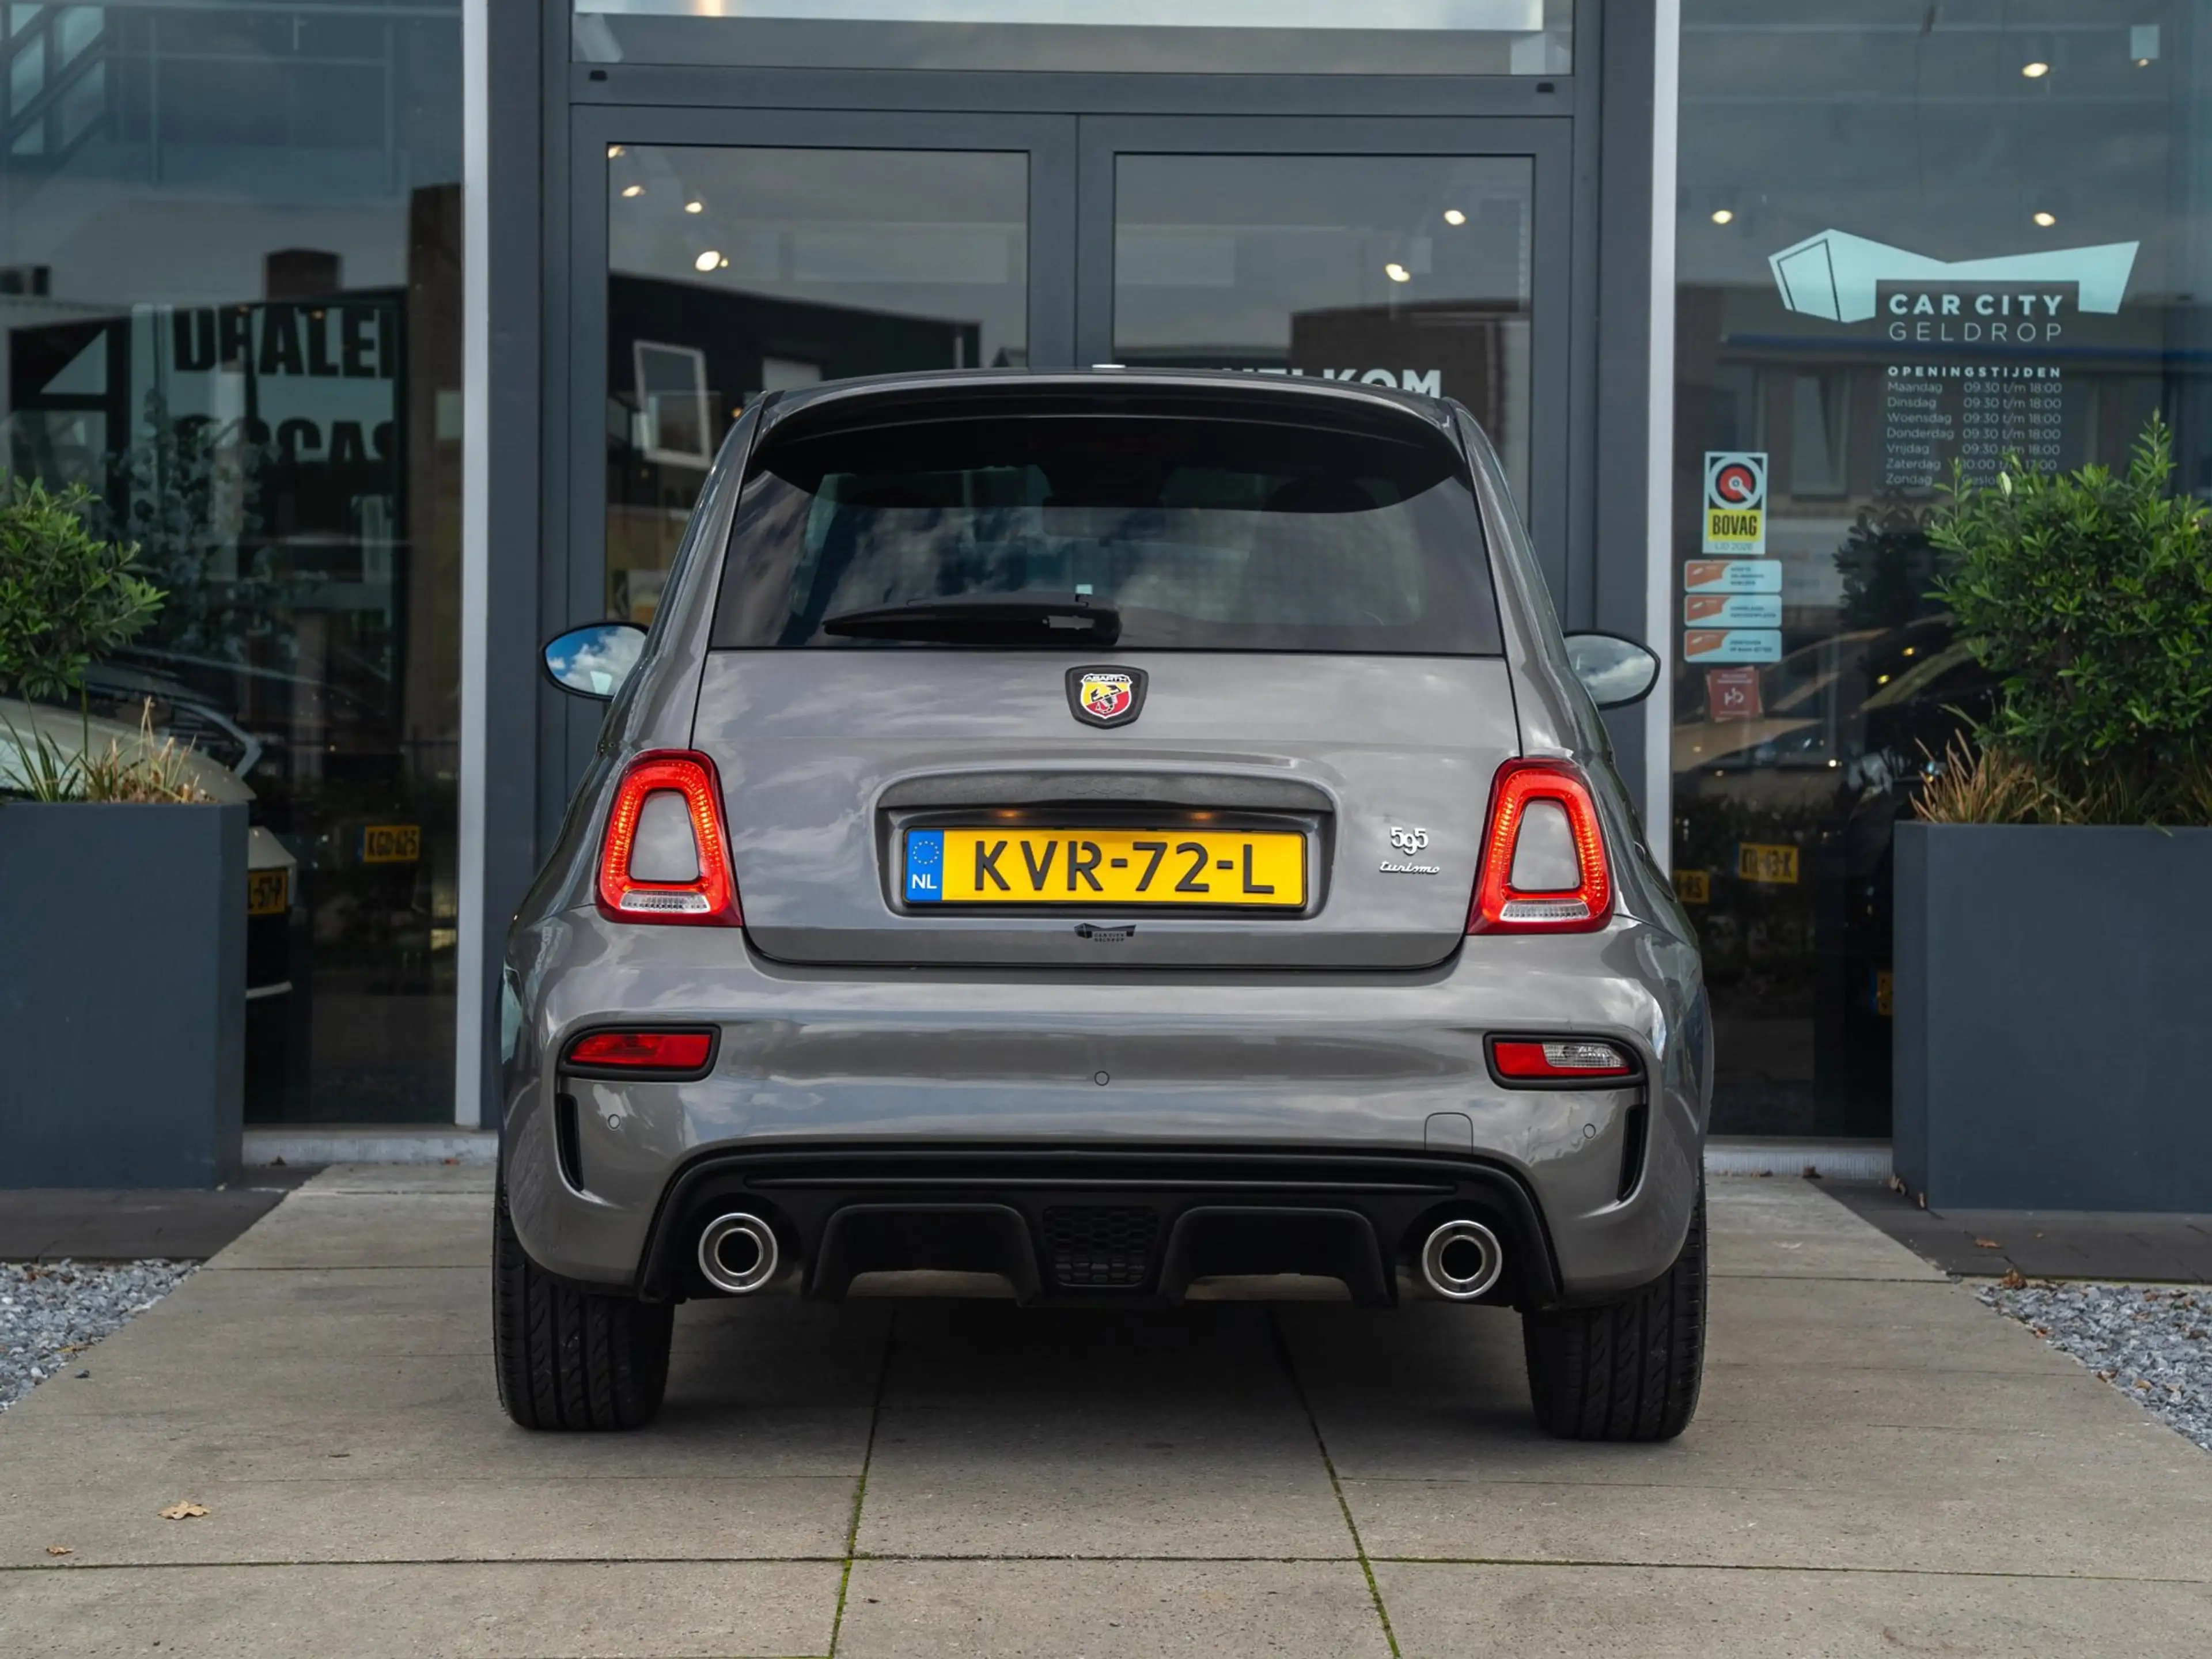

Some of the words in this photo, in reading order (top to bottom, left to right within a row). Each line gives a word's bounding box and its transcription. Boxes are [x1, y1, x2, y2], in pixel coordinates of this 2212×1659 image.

[1889, 294, 1961, 316] CAR
[1975, 294, 2063, 316] CITY
[1889, 321, 2062, 342] GELDROP
[1888, 366, 2061, 377] OPENINGSTIJDEN
[1888, 381, 1942, 394] Maandag
[1963, 382, 2000, 393] 09:30
[2003, 381, 2026, 393] t/m
[2030, 382, 2062, 393] 18:00
[1887, 396, 1937, 410] Dinsdag
[1963, 397, 1999, 408] 09:30
[2003, 397, 2025, 409] t/m
[2029, 397, 2062, 409] 18:00
[1887, 412, 1952, 425] Woensdag
[1963, 412, 1999, 424] 09:30
[2002, 412, 2025, 425] t/m
[2028, 412, 2061, 424] 18:00
[1887, 427, 1954, 441] Donderdag
[1963, 428, 1999, 439] 09:30
[2002, 428, 2025, 440] t/m
[2028, 429, 2061, 440] 18:00
[1886, 442, 1930, 455] Vrijdag
[1962, 443, 1998, 454] 09:30
[2028, 444, 2061, 454] 18:00
[1886, 458, 1941, 471] Zaterdag
[1885, 473, 1933, 486] Zondag
[1713, 514, 1758, 536] BOVAG
[1391, 827, 1429, 855] 595
[974, 840, 1275, 894] KVR-72-L
[1380, 861, 1440, 873] turismo
[911, 874, 937, 889] NL
